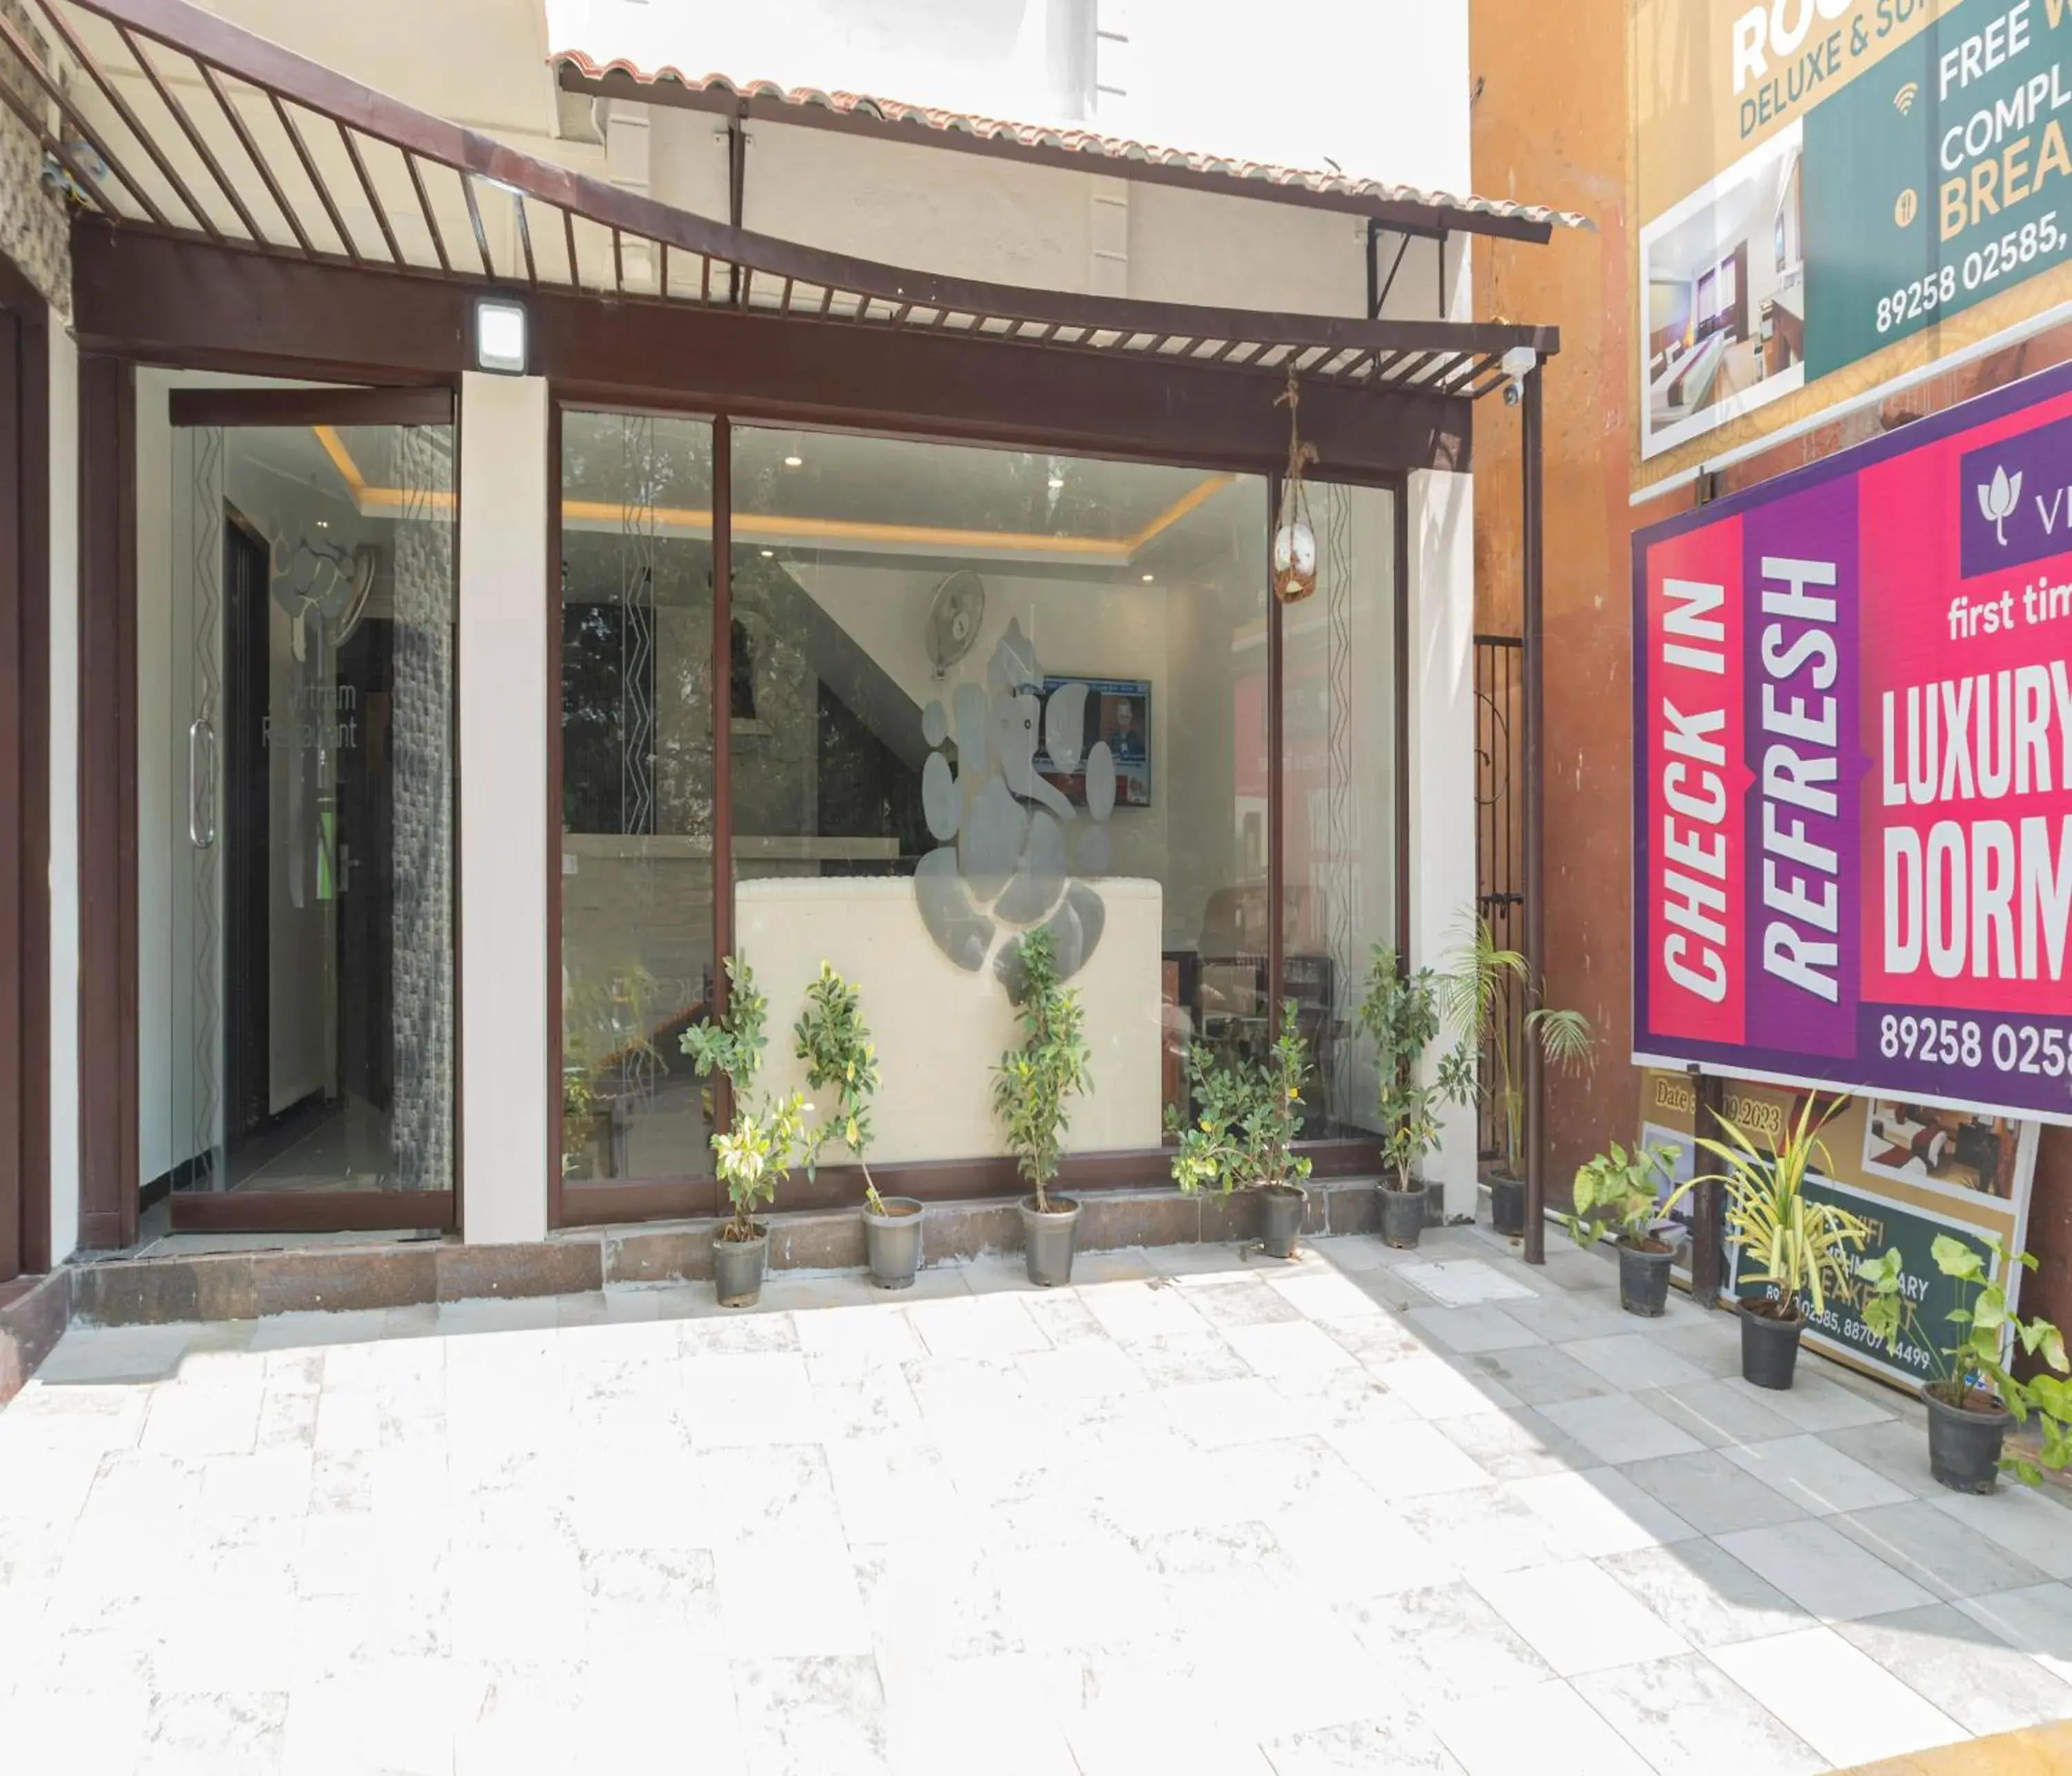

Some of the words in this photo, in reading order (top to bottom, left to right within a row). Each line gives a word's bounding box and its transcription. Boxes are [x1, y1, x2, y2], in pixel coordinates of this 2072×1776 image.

[1732, 0, 1852, 96] RO
[1740, 30, 1841, 139] DELUXE
[1850, 13, 1869, 57] &
[1876, 0, 1924, 38] SU
[1939, 0, 2031, 102] FREE
[1939, 61, 2072, 171] COMPL
[1940, 119, 2072, 243] BREA
[1876, 264, 1956, 334] 89258
[1962, 210, 2067, 291] 02585,
[1662, 577, 1725, 675] IN
[1948, 595, 2015, 641] first
[1761, 555, 1839, 1003] REFRESH
[1663, 696, 1727, 1003] CHECK
[1883, 813, 2072, 981] DORM
[1656, 1079, 1688, 1111] Date
[1880, 1014, 1982, 1068] 89258
